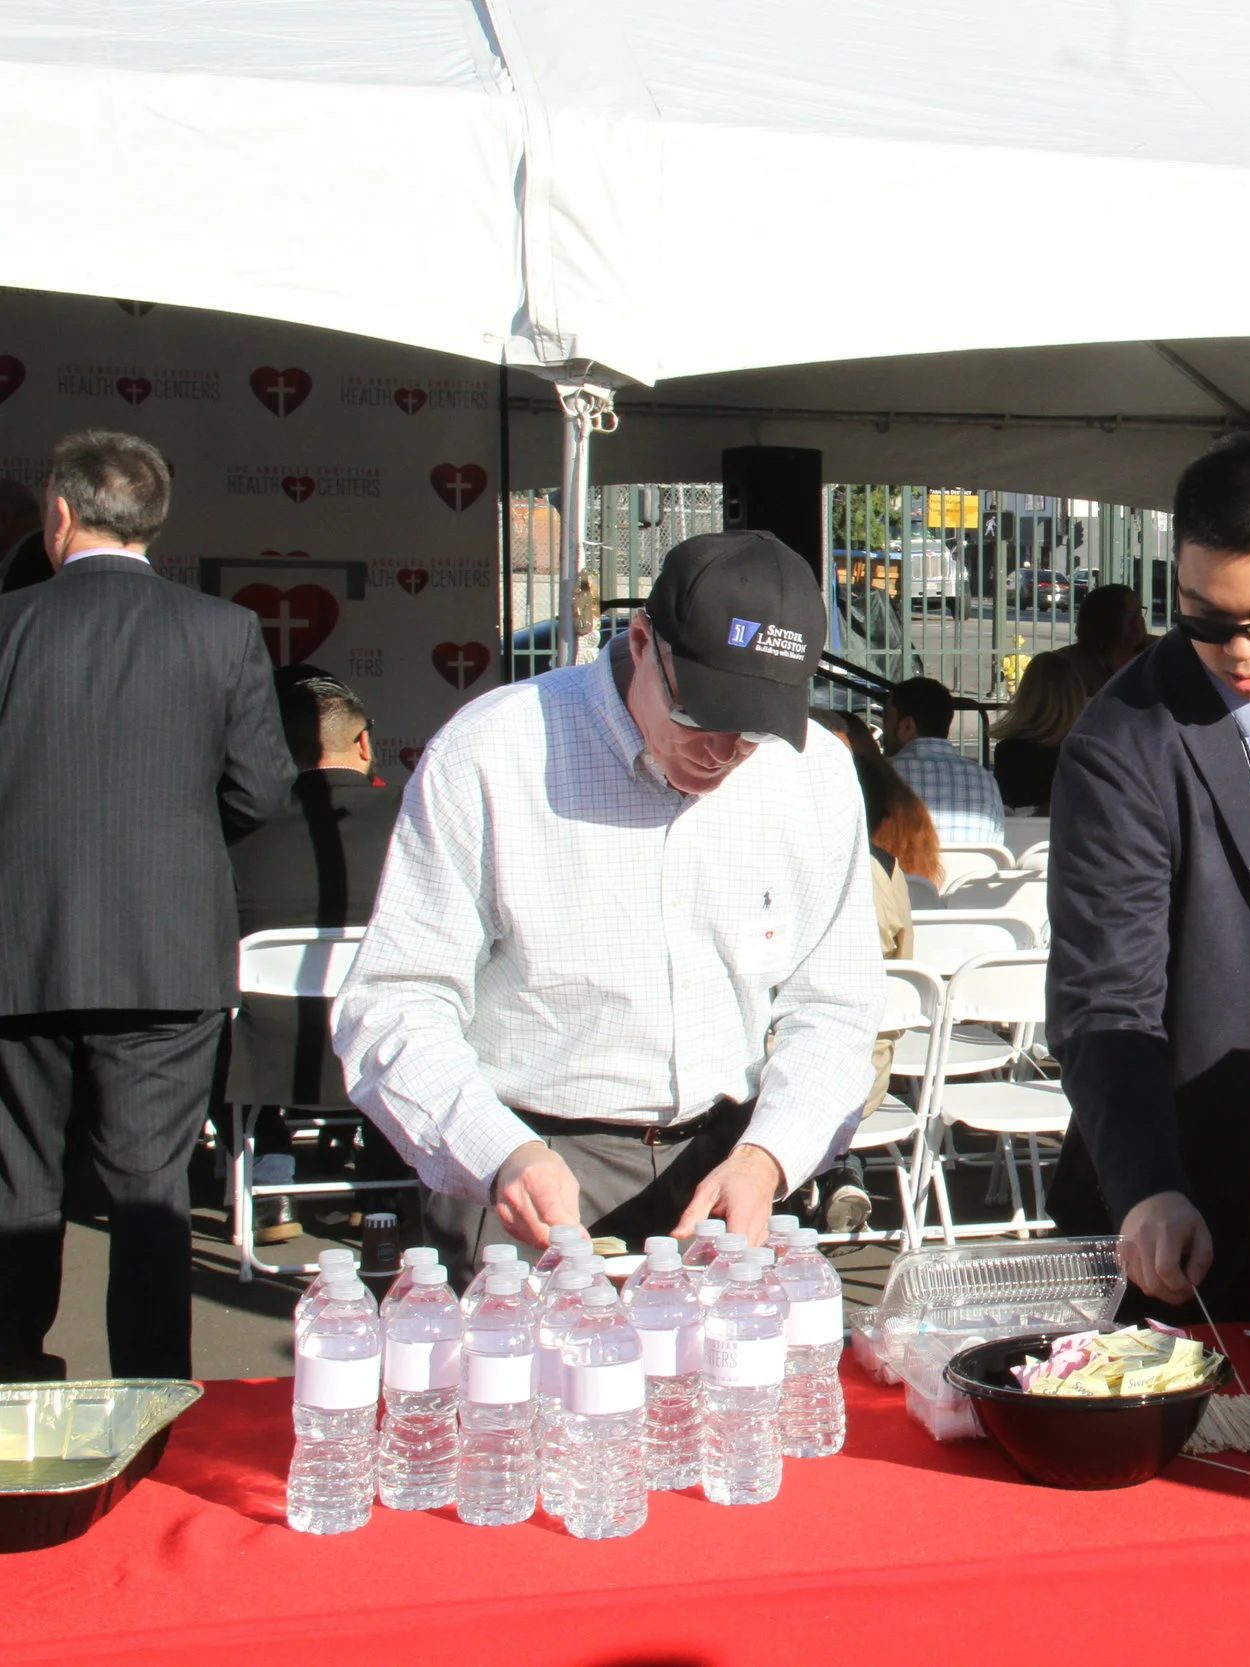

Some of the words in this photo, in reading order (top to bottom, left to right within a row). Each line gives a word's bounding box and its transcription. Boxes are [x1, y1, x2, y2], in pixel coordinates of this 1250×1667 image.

[57, 375, 114, 396] HEALTH
[154, 380, 221, 400] CENTERS
[340, 386, 392, 407] HEALTH
[428, 390, 489, 409] CENTERS
[226, 475, 280, 495] HEALTH
[317, 477, 381, 497] CENTERS
[430, 569, 491, 588] CENTERS
[757, 632, 807, 652] LANGSTON
[767, 624, 803, 643] SNYDER
[756, 645, 779, 656] Building
